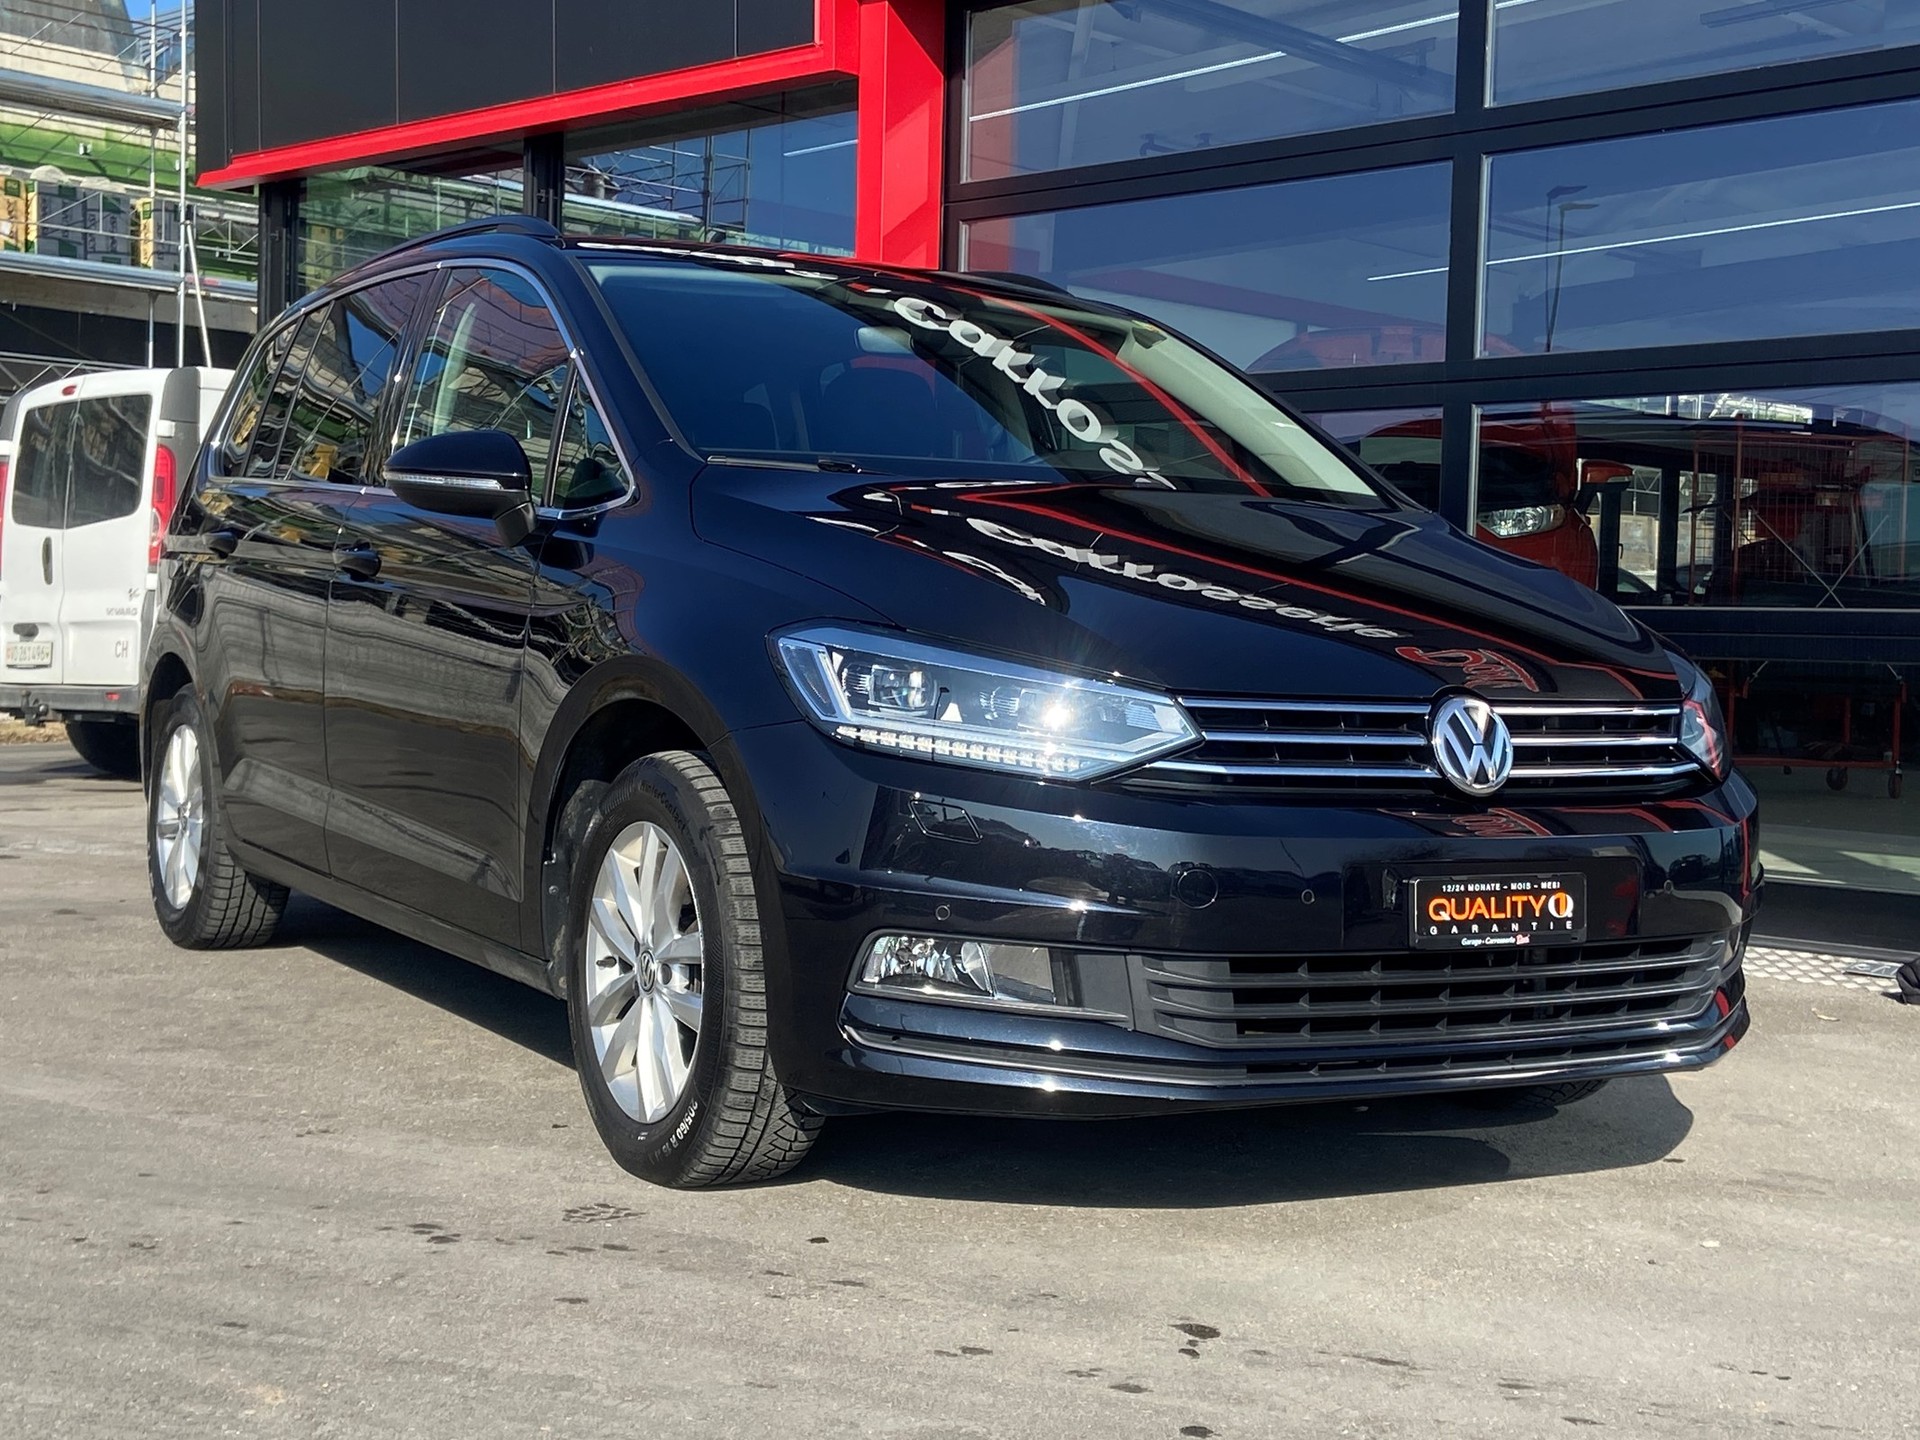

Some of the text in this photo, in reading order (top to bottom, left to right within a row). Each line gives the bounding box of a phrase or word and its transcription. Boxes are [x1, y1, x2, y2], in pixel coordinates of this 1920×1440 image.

[114, 640, 129, 658] CH
[1433, 697, 1513, 797] VW
[1467, 883, 1501, 892] MONATE
[1510, 882, 1531, 890] MOIS
[1428, 895, 1547, 921] QUALITY
[1429, 920, 1573, 935] GARANTIE
